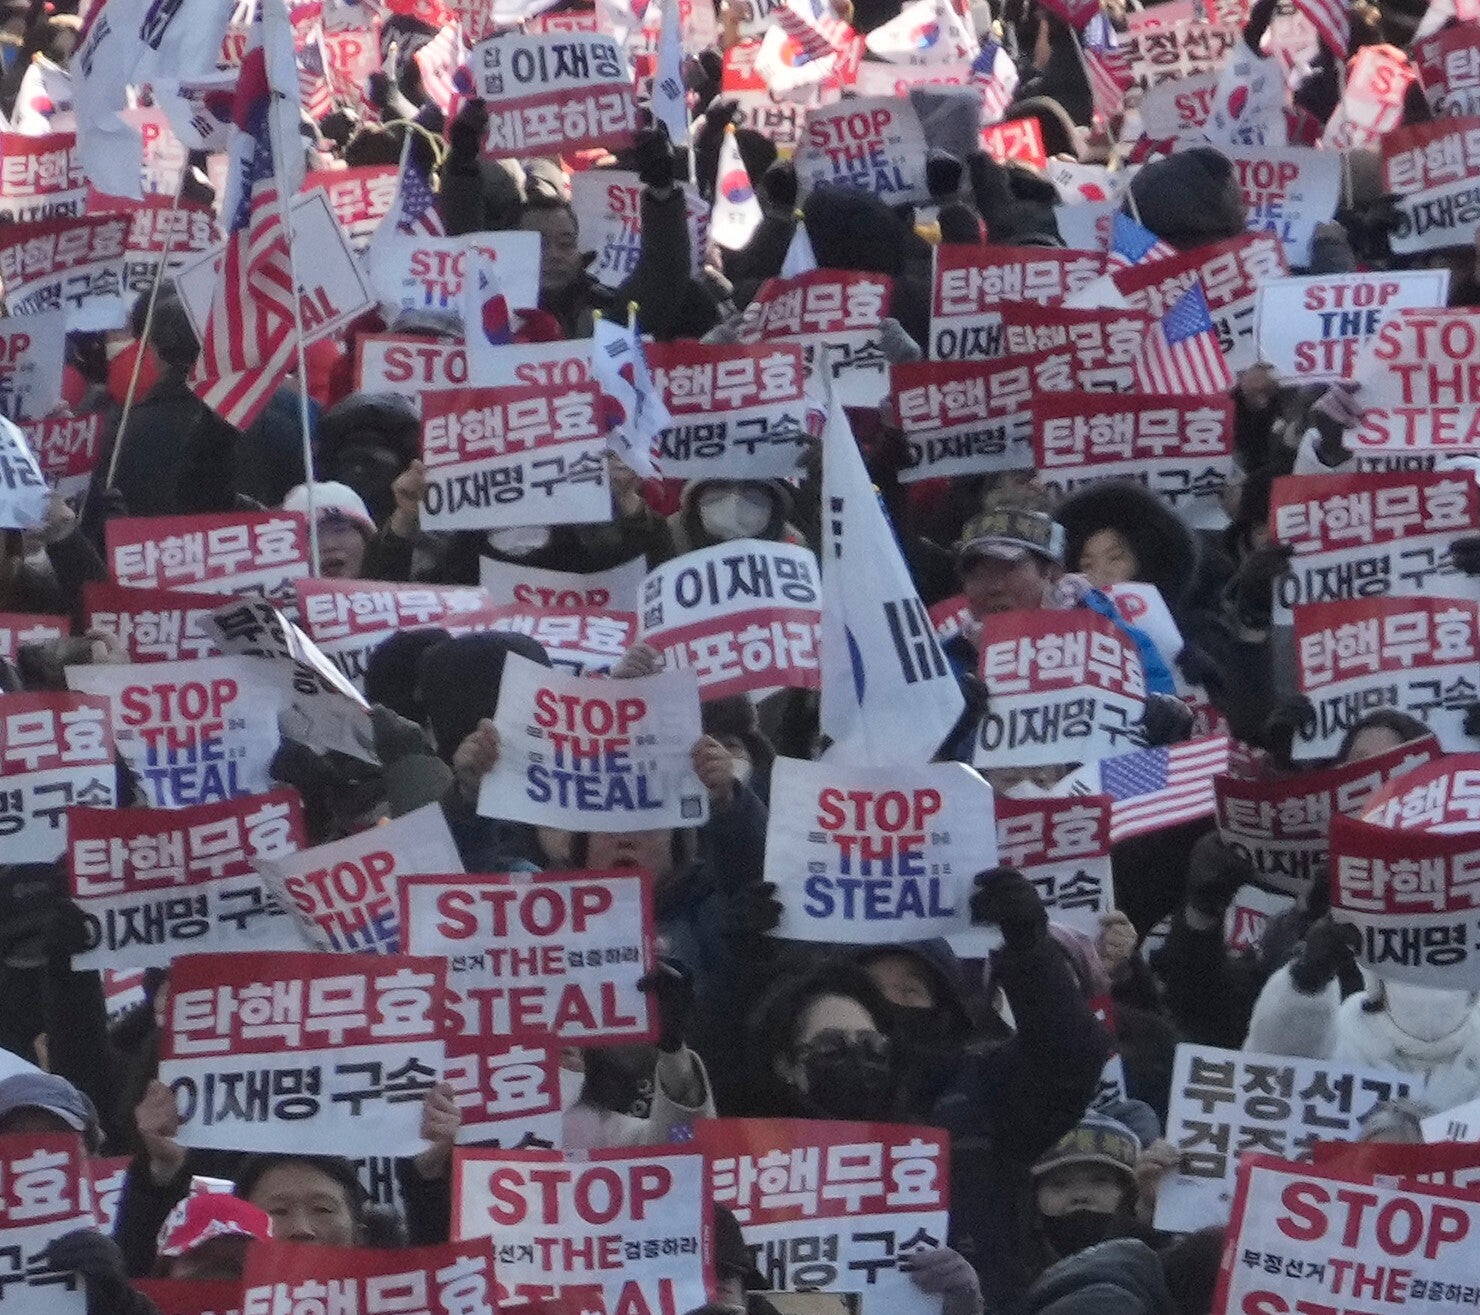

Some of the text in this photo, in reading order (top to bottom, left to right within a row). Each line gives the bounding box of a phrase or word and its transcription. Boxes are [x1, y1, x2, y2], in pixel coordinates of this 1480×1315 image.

[422, 391, 602, 459] 탄핵무효
[1275, 478, 1472, 548] 탄핵무효
[113, 517, 301, 588] 탄핵무효
[533, 689, 647, 734] STOP
[549, 732, 631, 773] THE
[526, 769, 662, 812] STEAL
[818, 788, 941, 831] STOP
[834, 833, 926, 878] THE
[438, 886, 612, 938] STOP
[805, 877, 952, 920] STEAL
[486, 946, 564, 976] THE
[173, 968, 444, 1054] 탄핵무효
[486, 1165, 670, 1226] STOP
[1275, 1179, 1470, 1257] STOP
[539, 1238, 623, 1273] THE
[1326, 1257, 1410, 1304] THE
